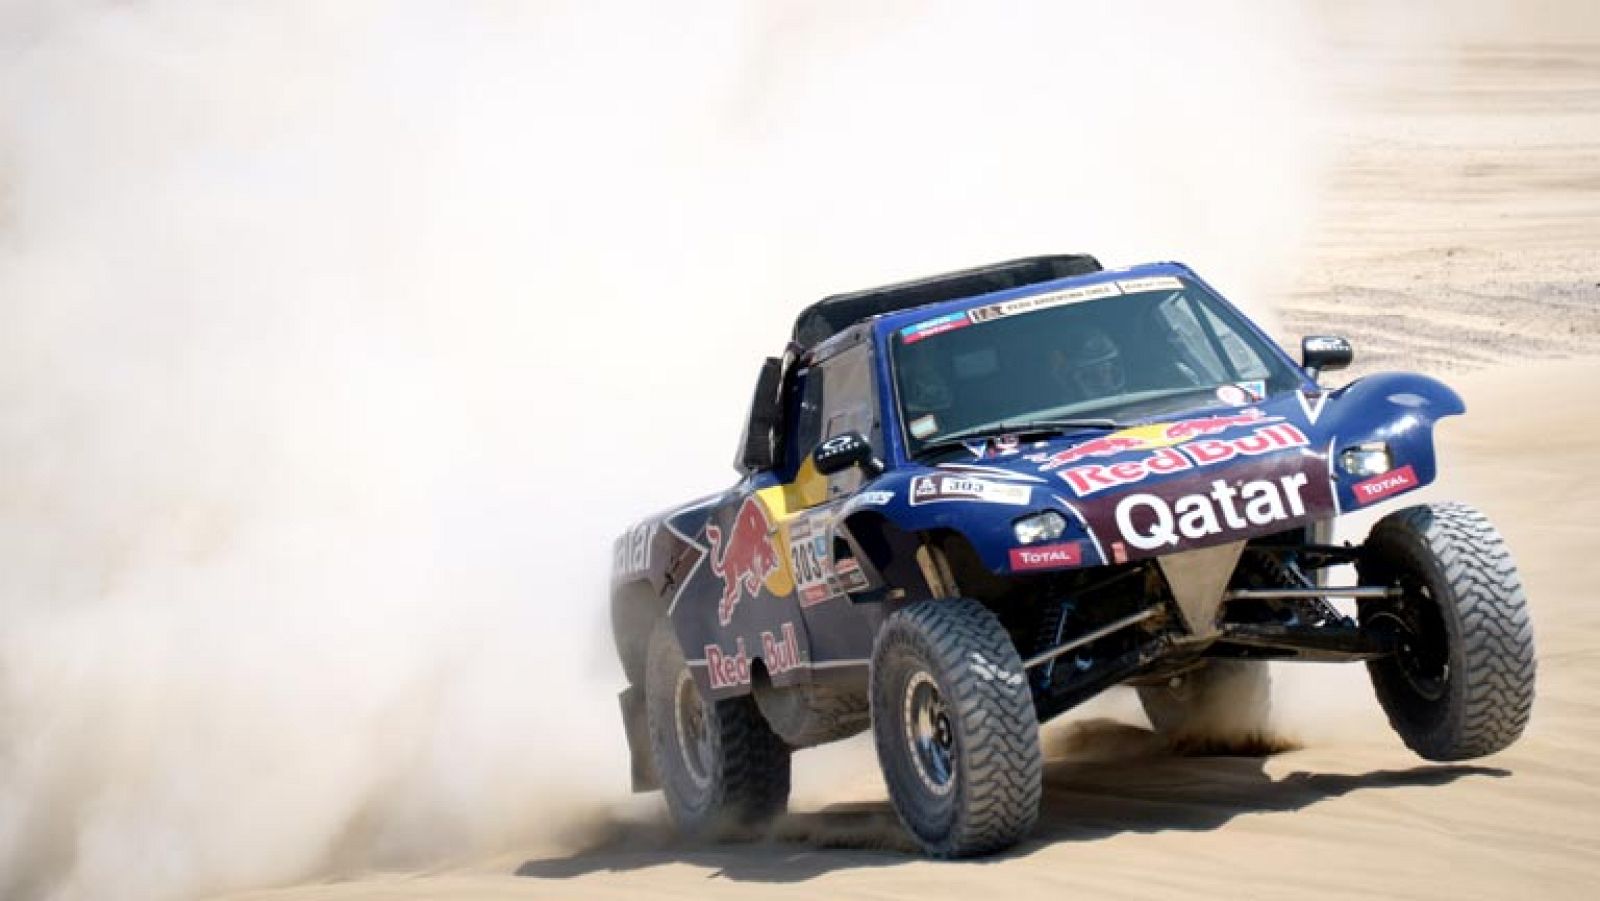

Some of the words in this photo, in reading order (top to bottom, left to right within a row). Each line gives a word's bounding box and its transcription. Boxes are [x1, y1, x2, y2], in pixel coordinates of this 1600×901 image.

[1056, 448, 1194, 497] Red
[1180, 423, 1311, 467] Bull
[1364, 474, 1409, 496] TOTAL
[949, 480, 984, 492] 303
[1115, 472, 1309, 550] Qatar
[613, 518, 660, 575] atar
[791, 541, 822, 585] 303
[1019, 550, 1072, 564] TOTAL
[704, 636, 750, 689] Red
[761, 622, 800, 676] Bull
